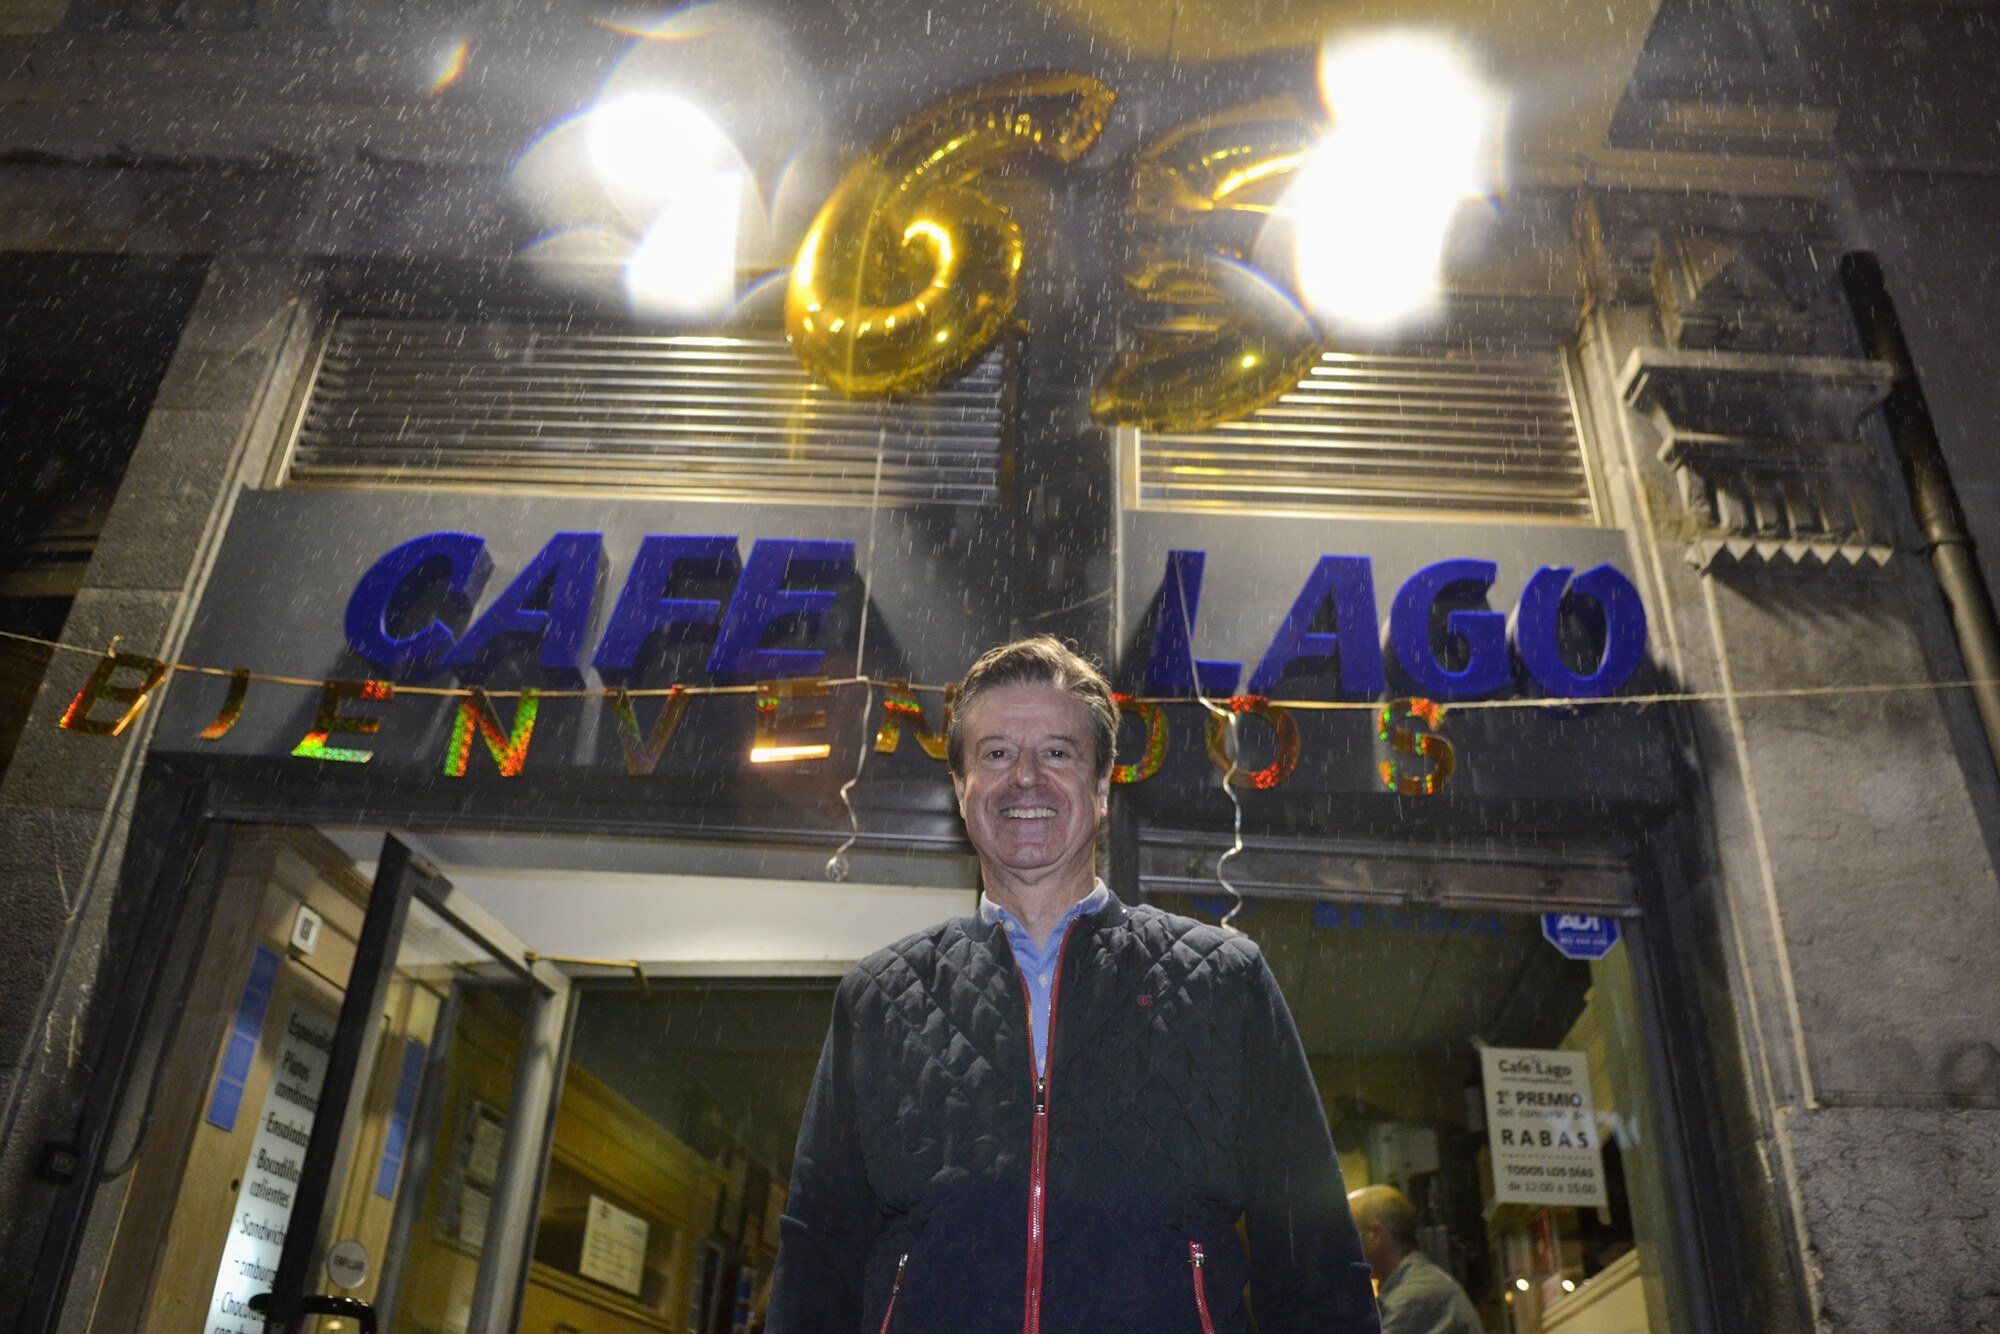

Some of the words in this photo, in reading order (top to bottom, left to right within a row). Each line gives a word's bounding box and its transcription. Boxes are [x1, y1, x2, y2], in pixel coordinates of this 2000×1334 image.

[345, 531, 855, 674] CAFE
[1147, 549, 1647, 702] LAGO
[58, 650, 1456, 795] BIENVENDOS
[1536, 1062, 1572, 1077] Lago
[1516, 1091, 1583, 1107] PREMIO
[1502, 1129, 1588, 1148] RABAS
[1506, 1164, 1545, 1177] TODOS
